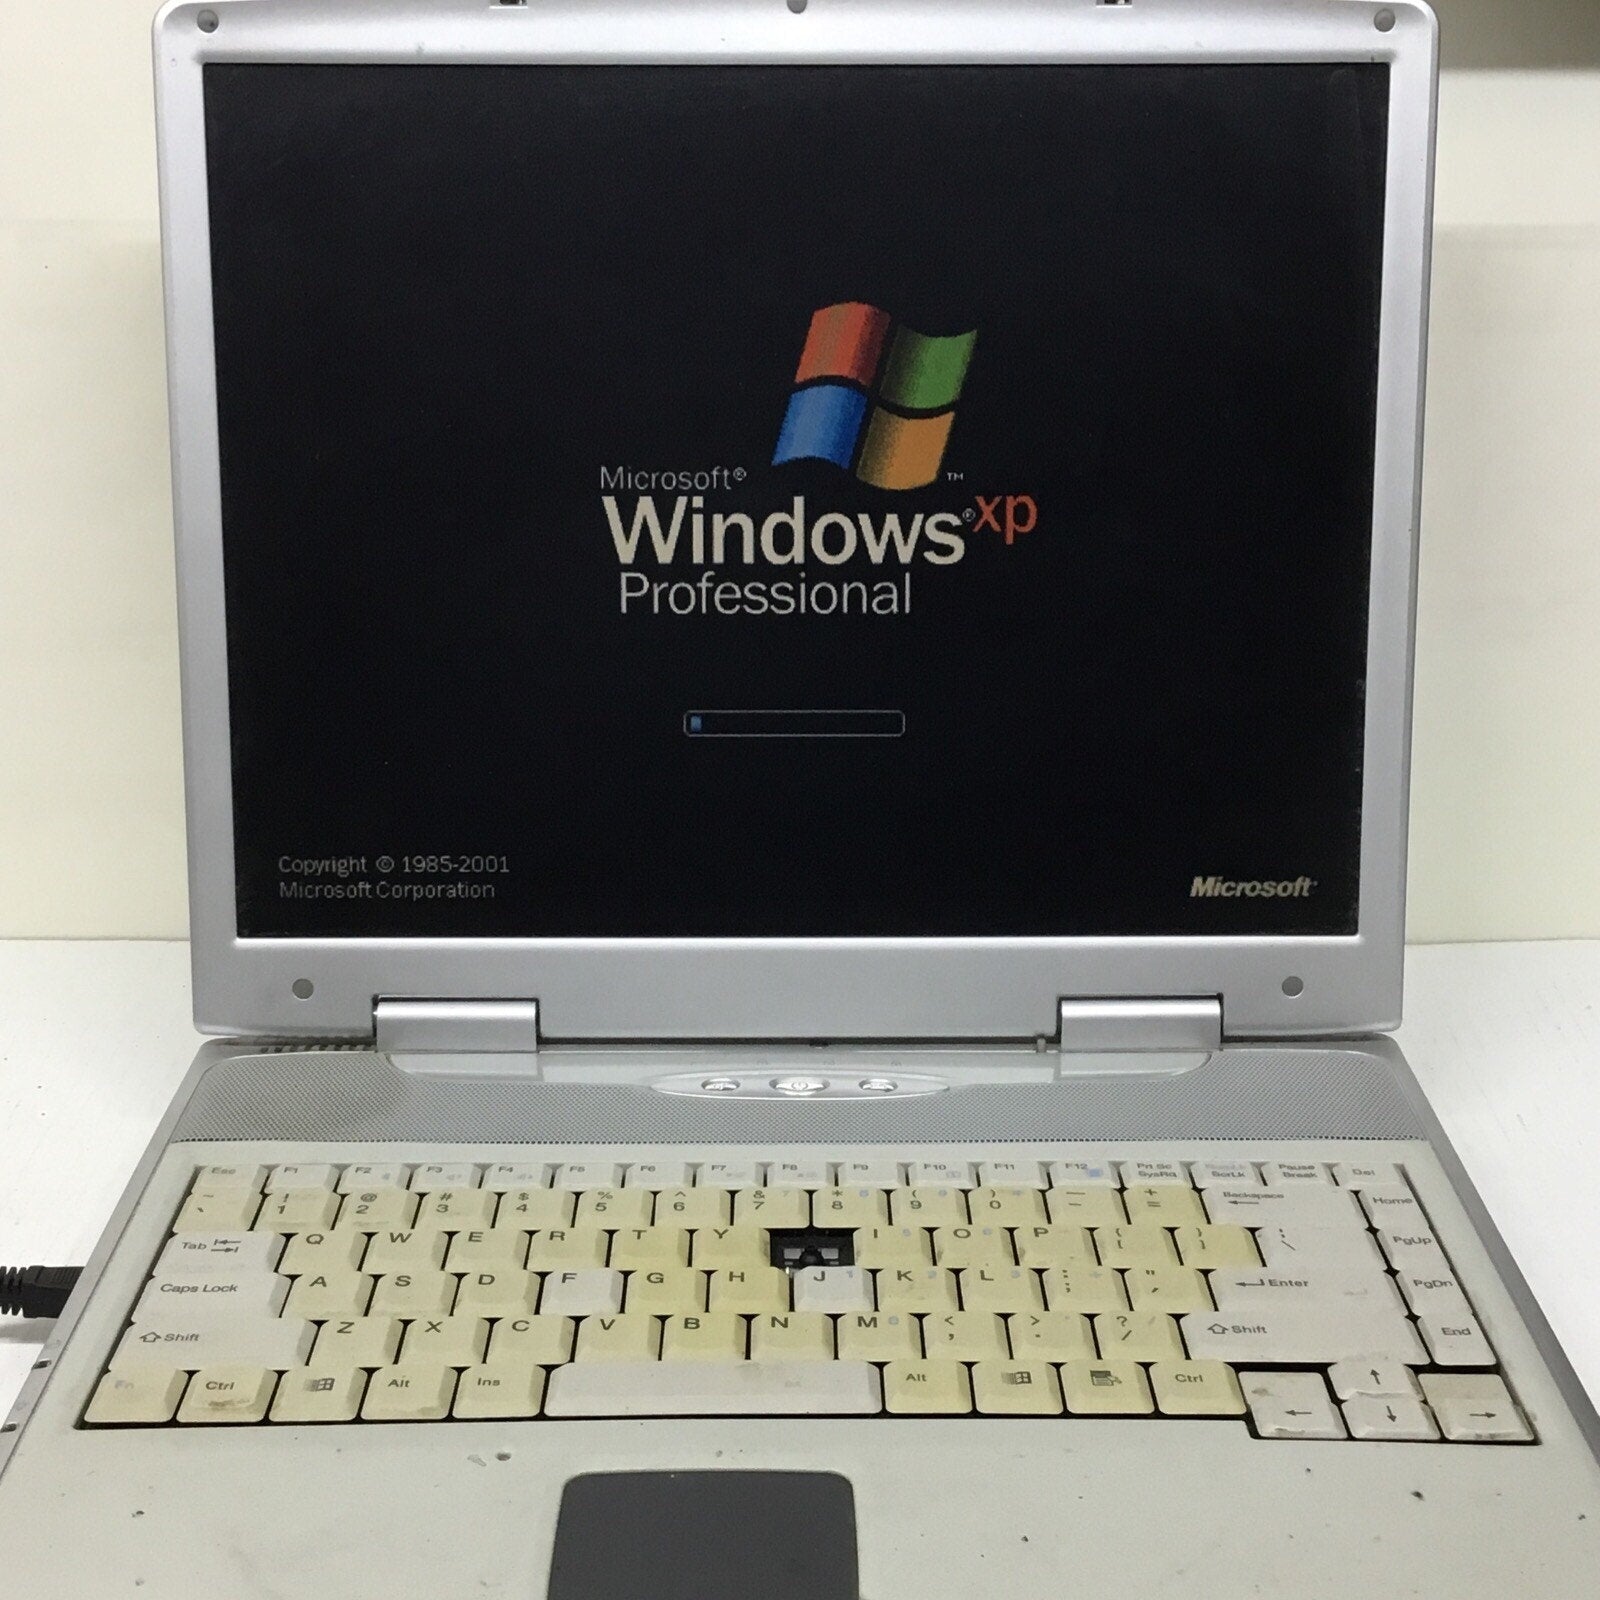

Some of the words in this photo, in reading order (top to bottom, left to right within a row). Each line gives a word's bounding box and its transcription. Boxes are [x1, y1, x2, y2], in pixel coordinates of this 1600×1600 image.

[971, 495, 1038, 545] xp
[620, 570, 911, 615] Professional
[278, 855, 368, 878] Copyright
[402, 855, 510, 873] 1985-2001
[279, 881, 373, 899] Microsoft
[376, 880, 495, 902] Corporation
[283, 1166, 299, 1174] F1
[354, 1166, 372, 1174] F2
[426, 1166, 443, 1174] F3
[498, 1165, 514, 1173] F4
[711, 1164, 727, 1172] F7
[852, 1163, 869, 1171] F9
[923, 1163, 947, 1171] F10
[993, 1162, 1015, 1171] F11
[1064, 1162, 1088, 1171] F12
[1278, 1162, 1316, 1170] Pause
[1138, 1171, 1178, 1179] SysRq
[1211, 1170, 1246, 1178] ScrLk
[1282, 1171, 1318, 1179] Break
[1351, 1168, 1376, 1176] Del
[359, 1192, 378, 1203] @
[752, 1189, 766, 1200] &
[1222, 1191, 1285, 1200] Backspace
[1372, 1195, 1413, 1205] Home
[355, 1204, 370, 1215] 2
[435, 1203, 449, 1214] 3
[594, 1201, 608, 1212] 5
[673, 1201, 686, 1212] 6
[753, 1200, 765, 1211] 7
[909, 1199, 923, 1210] 9
[989, 1199, 1002, 1210] 0
[389, 1232, 413, 1244] W
[467, 1231, 484, 1243] E
[548, 1230, 566, 1242] R
[631, 1229, 647, 1240] T
[713, 1228, 729, 1240] Y
[952, 1228, 972, 1239] O
[1033, 1227, 1049, 1238] P
[305, 1233, 325, 1245] Q
[1392, 1235, 1432, 1246] PgUp
[182, 1241, 207, 1250] Tab
[477, 1273, 496, 1286] D
[561, 1272, 577, 1284] F
[646, 1272, 665, 1284] G
[728, 1271, 745, 1283] H
[813, 1270, 826, 1282] J
[896, 1269, 914, 1282] K
[979, 1269, 995, 1282] L
[308, 1275, 327, 1288] A
[394, 1275, 412, 1288] S
[1267, 1278, 1309, 1287] Enter
[1412, 1279, 1454, 1290] PgDn
[160, 1283, 199, 1295] Caps
[202, 1284, 238, 1293] Lock
[511, 1319, 530, 1332] C
[599, 1318, 616, 1331] V
[683, 1317, 701, 1330] B
[770, 1316, 789, 1329] N
[857, 1315, 878, 1329] M
[1116, 1315, 1128, 1327] ?
[336, 1321, 355, 1334] Z
[424, 1320, 443, 1334] X
[1230, 1325, 1268, 1334] Shift
[1440, 1327, 1472, 1336] End
[163, 1333, 200, 1342] Shift
[387, 1378, 410, 1388] Alt
[477, 1377, 501, 1387] Ins
[905, 1373, 927, 1382] Alt
[1174, 1373, 1204, 1383] Ctrl
[205, 1380, 235, 1391] Ctrl
